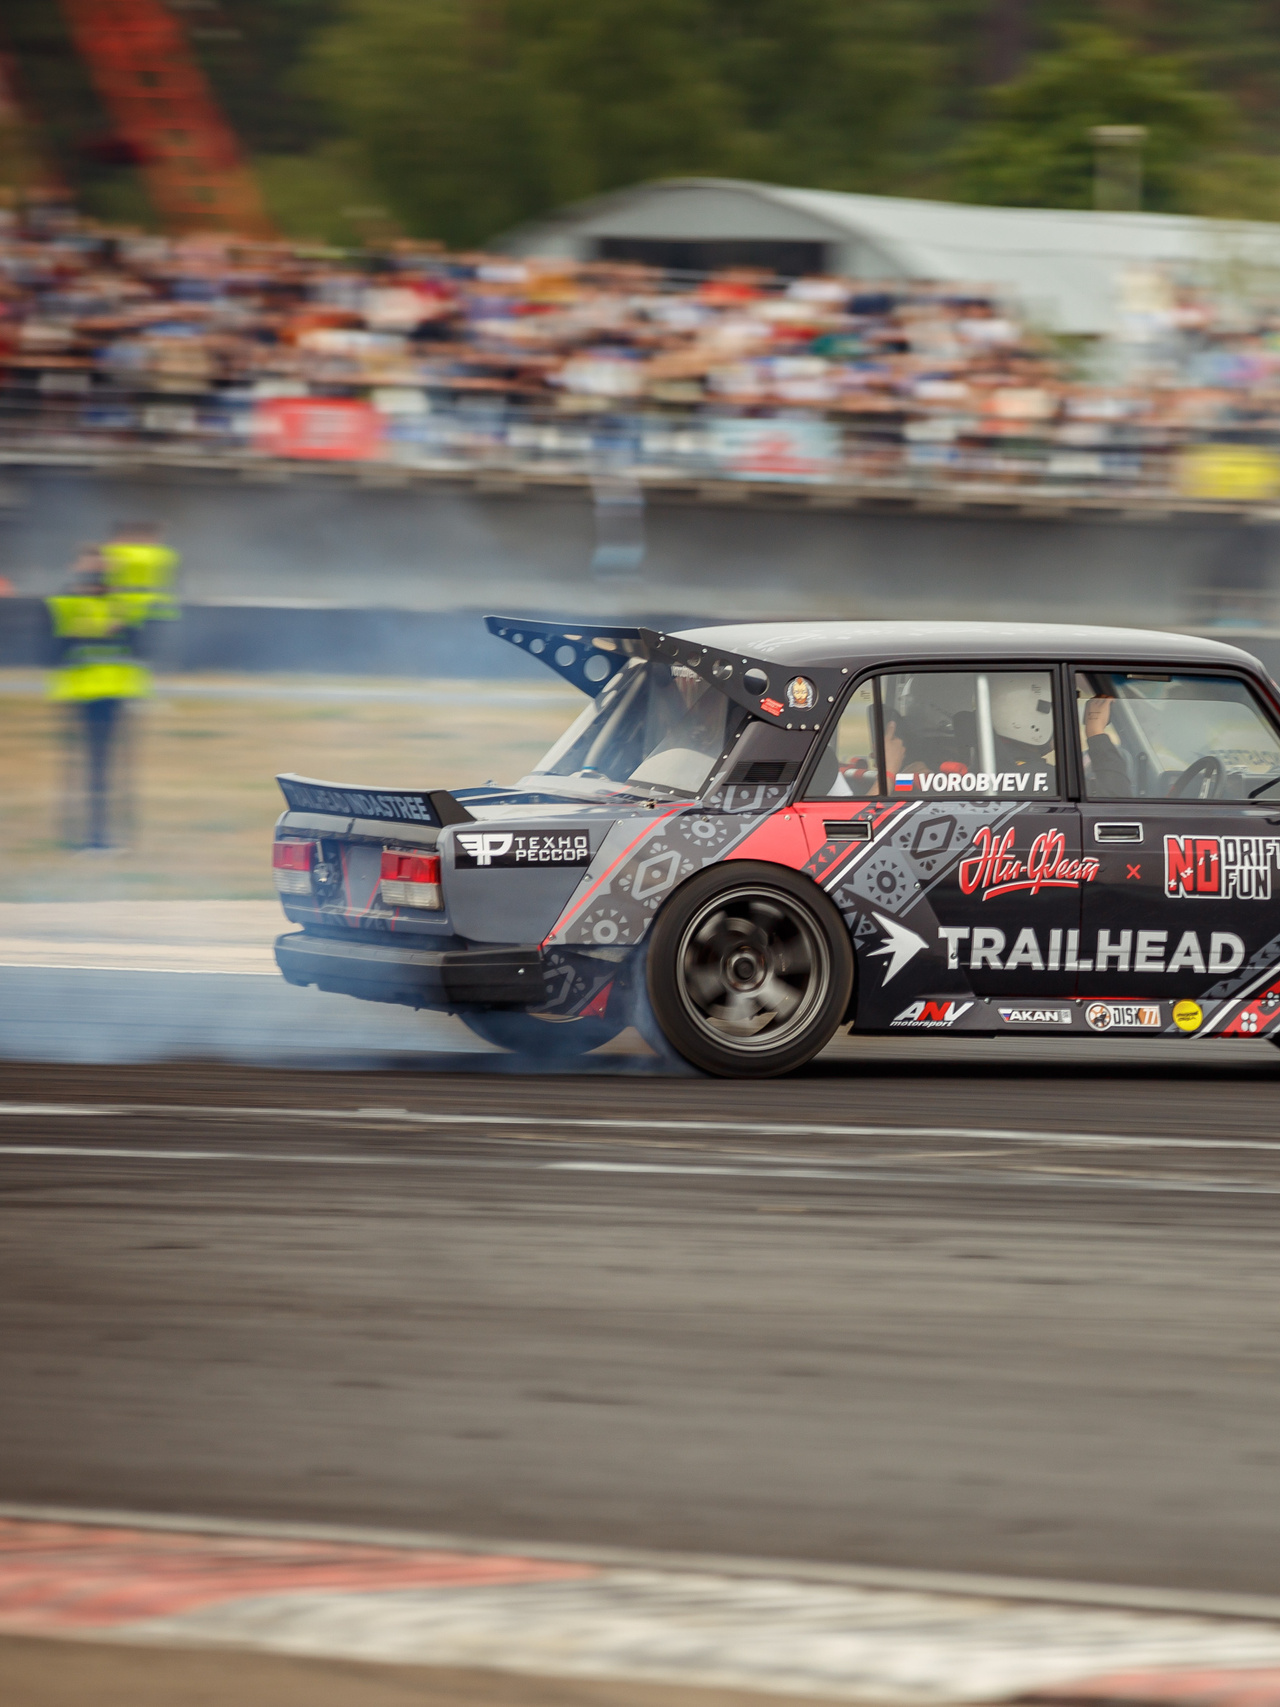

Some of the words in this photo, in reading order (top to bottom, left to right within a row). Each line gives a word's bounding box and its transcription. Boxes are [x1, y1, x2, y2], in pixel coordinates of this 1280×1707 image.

[919, 773, 1030, 792] VOROBYEV
[1033, 773, 1049, 792] F.
[514, 836, 588, 849] ТЕХНО
[515, 849, 588, 861] РЕССОР
[1165, 836, 1222, 897] NO
[1223, 868, 1271, 899] FUN
[938, 926, 1246, 974] TRAILHEAD
[893, 1001, 975, 1021] ANV
[1009, 1010, 1059, 1022] AKAN
[889, 1020, 954, 1028] motorsport
